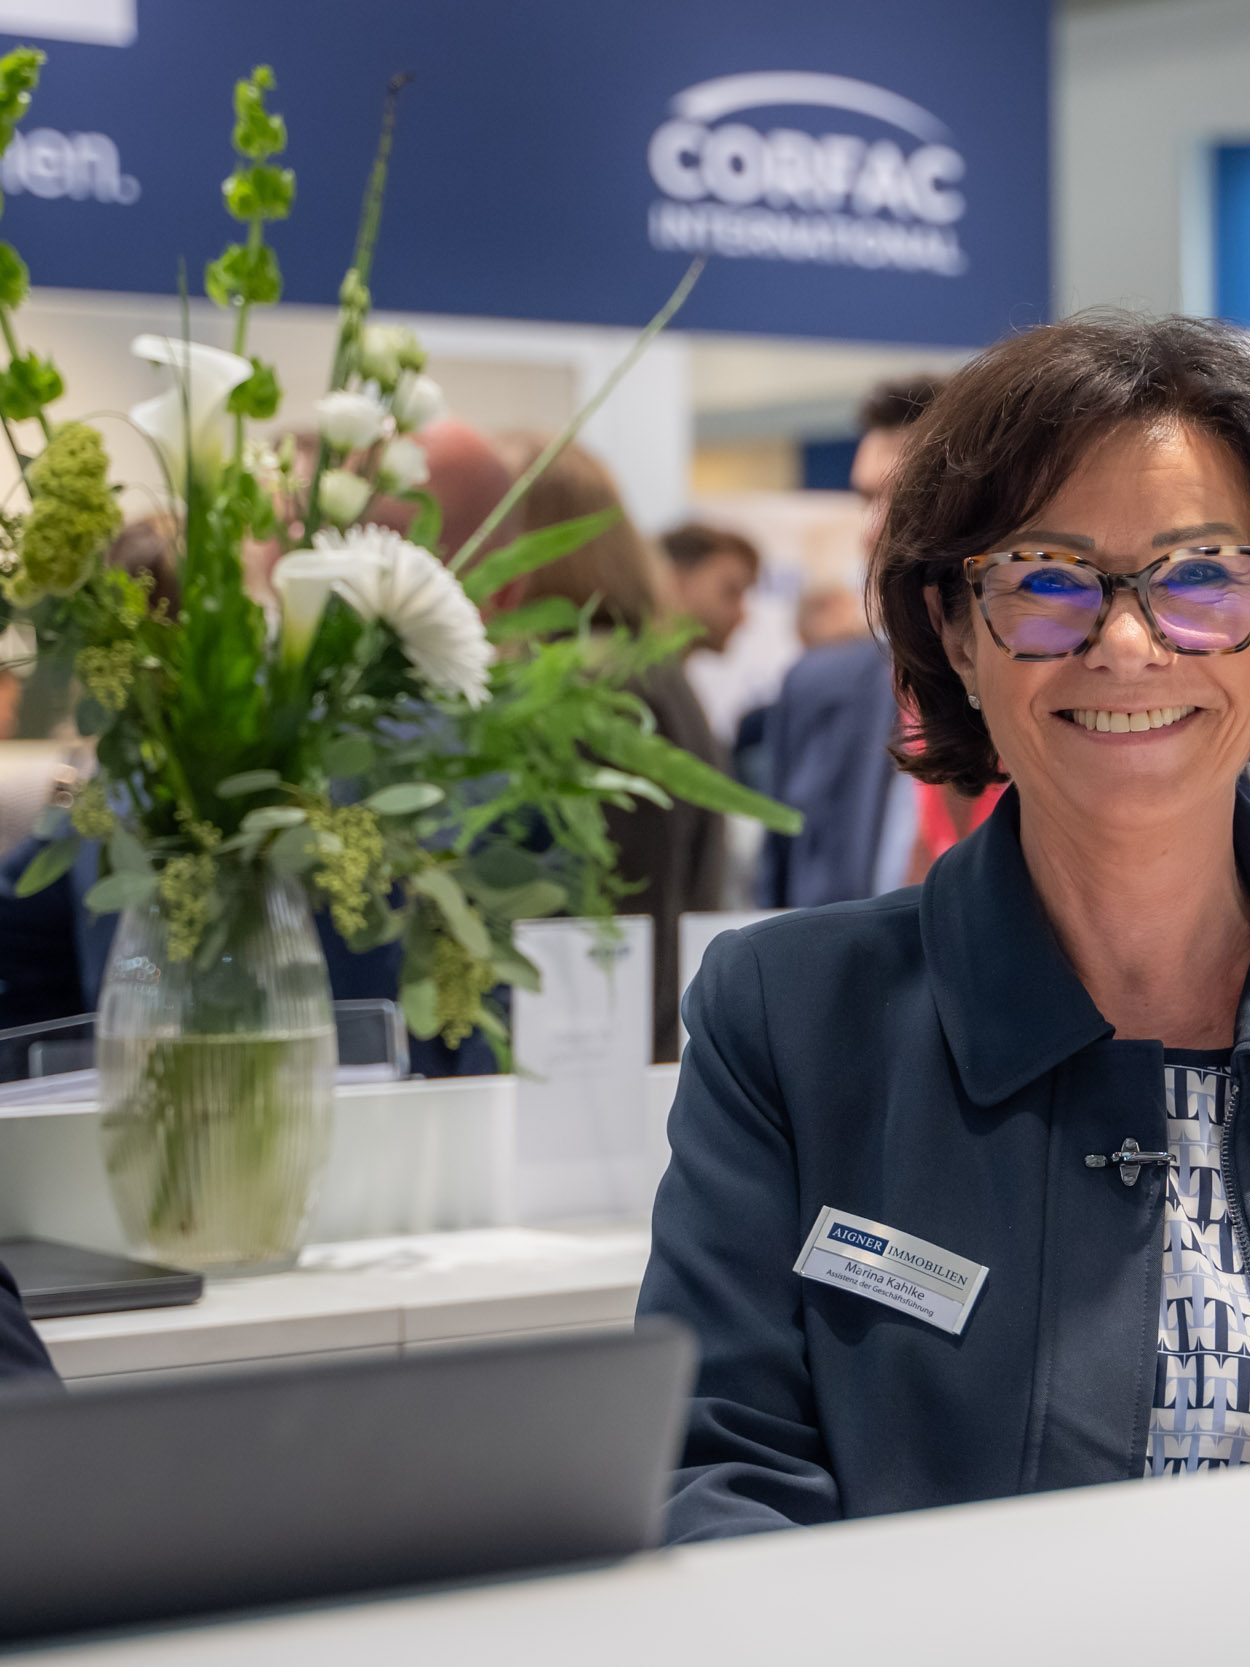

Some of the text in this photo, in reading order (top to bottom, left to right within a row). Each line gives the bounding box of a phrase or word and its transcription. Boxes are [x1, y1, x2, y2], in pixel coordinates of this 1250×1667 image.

[648, 118, 967, 225] CORFAC
[648, 200, 969, 277] INTERNATIONAL
[832, 1227, 969, 1287] AIGNER IMMOBILIEN
[844, 1261, 925, 1301] Marina Kahlke
[826, 1268, 934, 1318] Assistenz der Geschäftsführung
